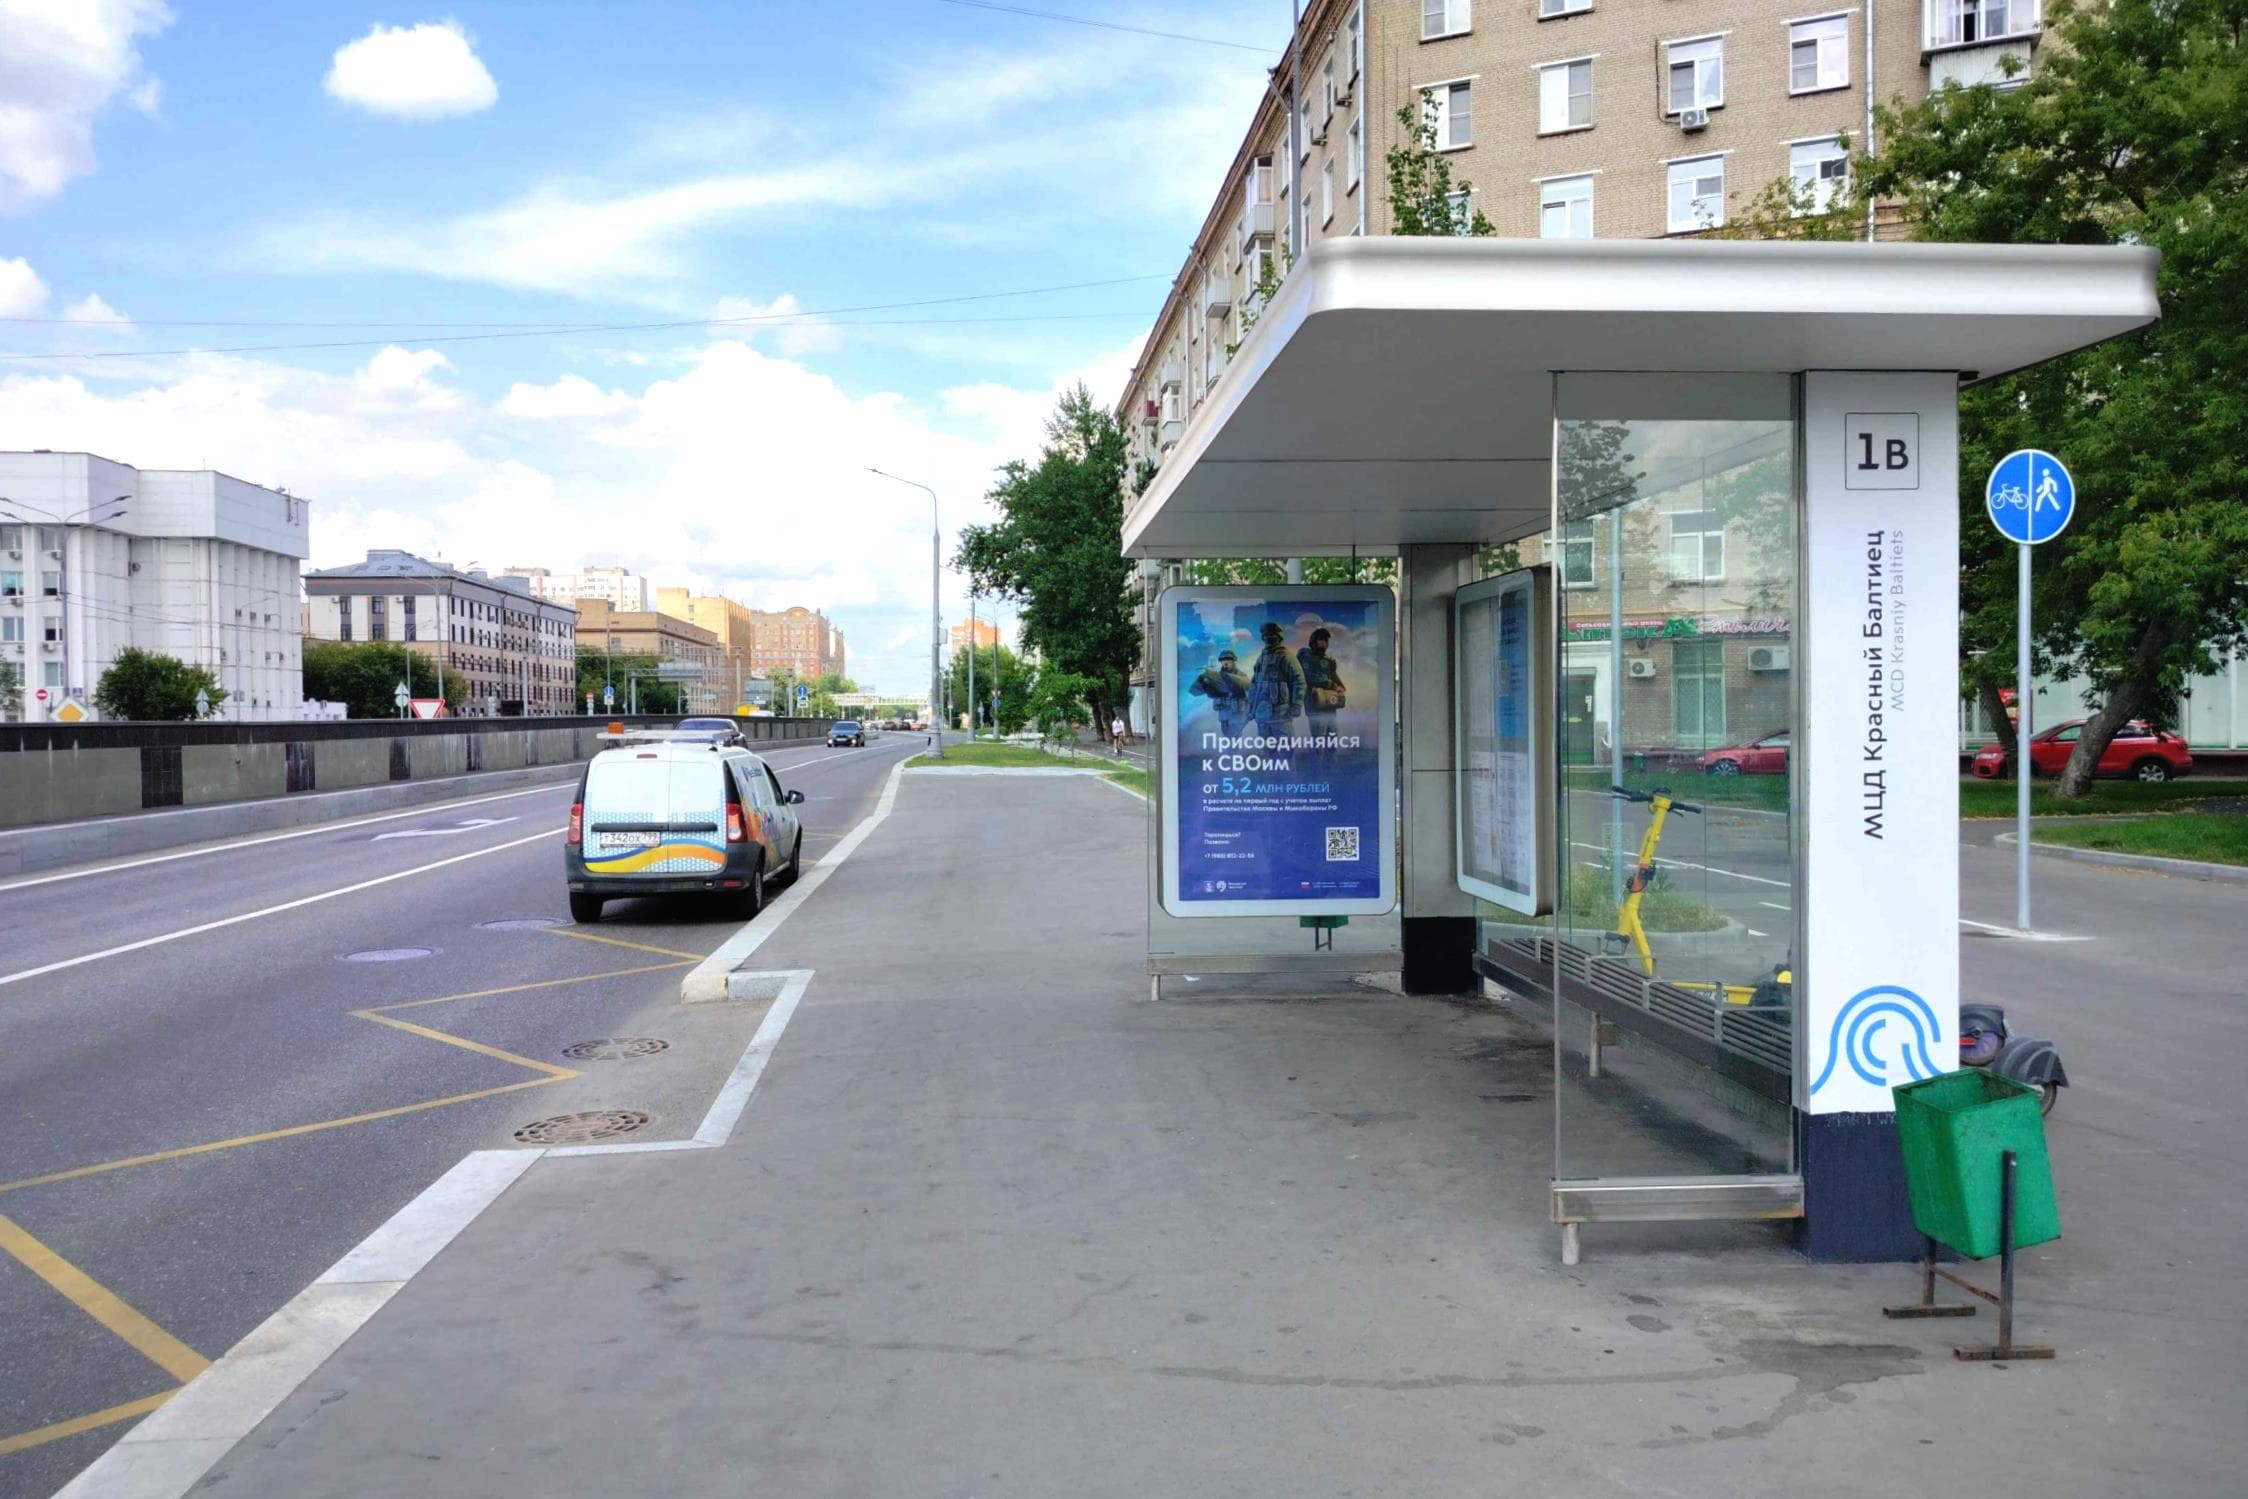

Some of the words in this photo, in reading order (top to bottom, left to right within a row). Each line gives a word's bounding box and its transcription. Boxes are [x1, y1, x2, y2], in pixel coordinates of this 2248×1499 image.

[1863, 530, 1885, 638] Балтиец
[1889, 530, 1904, 595] Baltiets
[1890, 600, 1907, 663] Krasniy
[1863, 647, 1887, 761] Красный
[1890, 669, 1904, 712] MCD
[1202, 732, 1360, 751] Присоединяйся
[1202, 759, 1213, 771] к
[1217, 755, 1290, 771] СВОим
[1203, 784, 1218, 793] от
[1222, 777, 1251, 796] 5,2
[1255, 784, 1283, 793] МЛН
[1286, 782, 1330, 793] РУБЛЕЙ
[1863, 770, 1886, 840] МЦД
